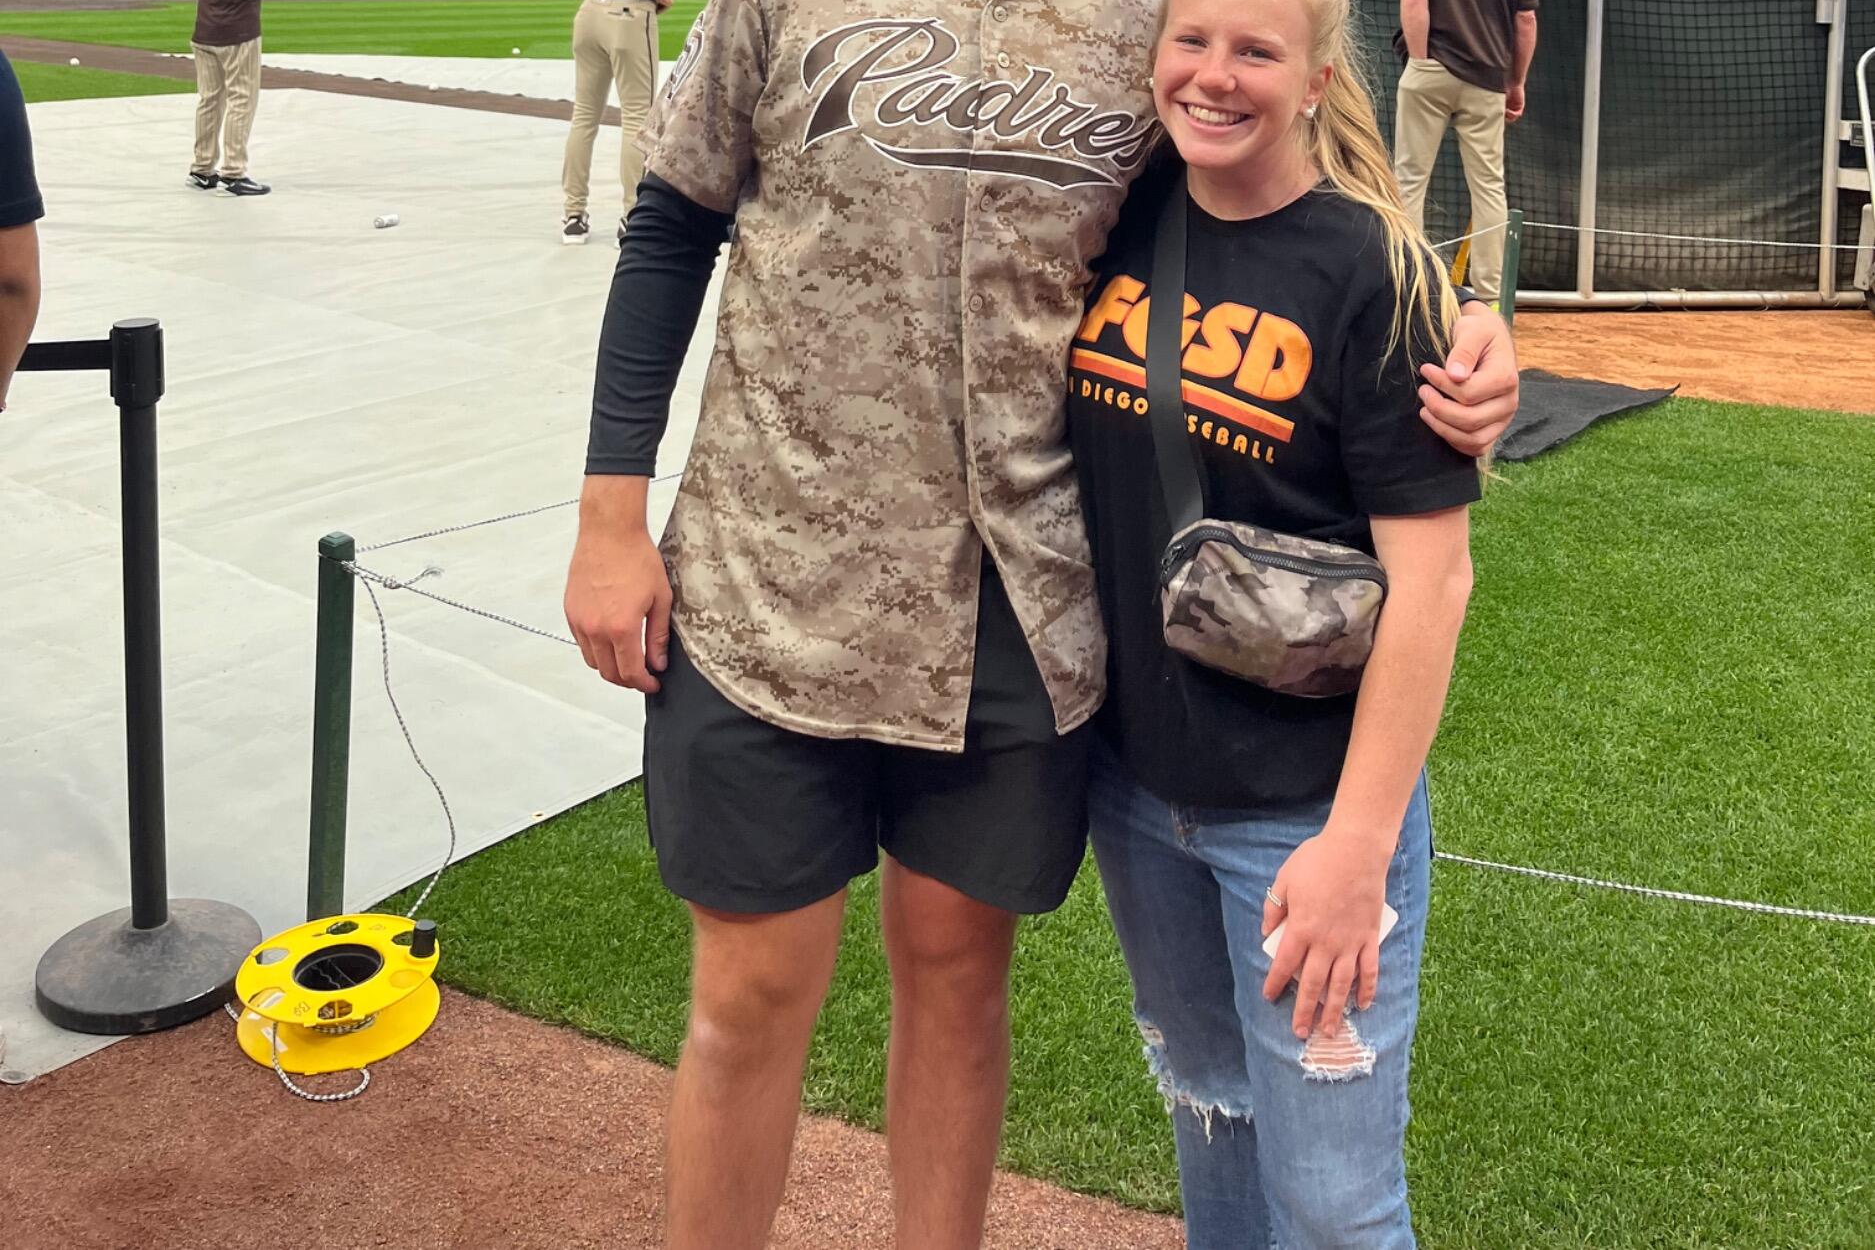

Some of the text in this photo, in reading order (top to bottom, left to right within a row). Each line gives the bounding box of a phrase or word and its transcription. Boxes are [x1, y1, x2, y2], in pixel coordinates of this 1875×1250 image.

[800, 18, 1164, 171] Padres
[1082, 379, 1149, 415] DIEGO
[1184, 414, 1275, 464] SEBALL
